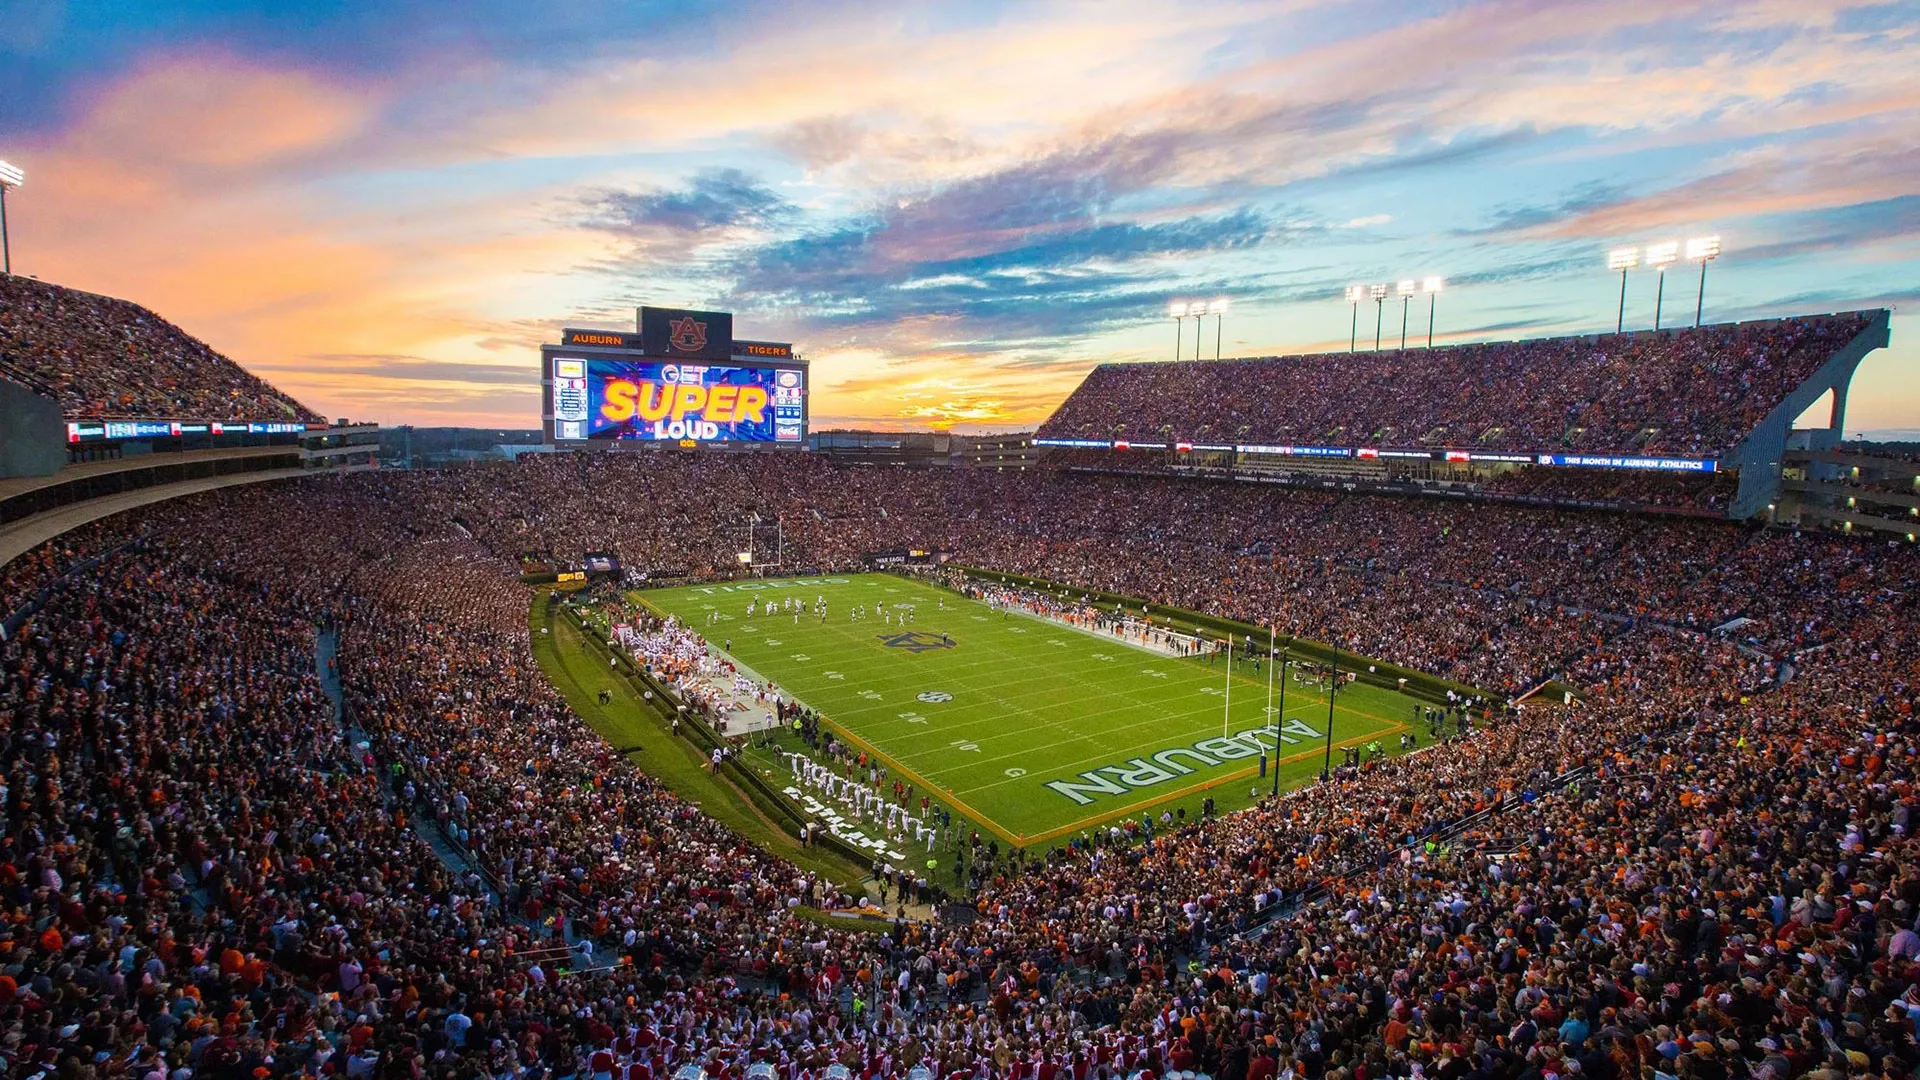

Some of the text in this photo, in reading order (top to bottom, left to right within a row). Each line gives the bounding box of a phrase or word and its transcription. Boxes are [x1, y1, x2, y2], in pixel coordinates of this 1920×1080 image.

[572, 334, 622, 345] AUBURN
[748, 345, 787, 356] TIGERS
[661, 364, 706, 385] GET
[601, 380, 766, 424] SUPER
[654, 421, 719, 440] LOUD
[1564, 457, 1703, 470] THIS MONTH IN AUBURN ATHLETICS
[691, 577, 850, 595] TIGERS
[1045, 717, 1326, 806] AUBURN
